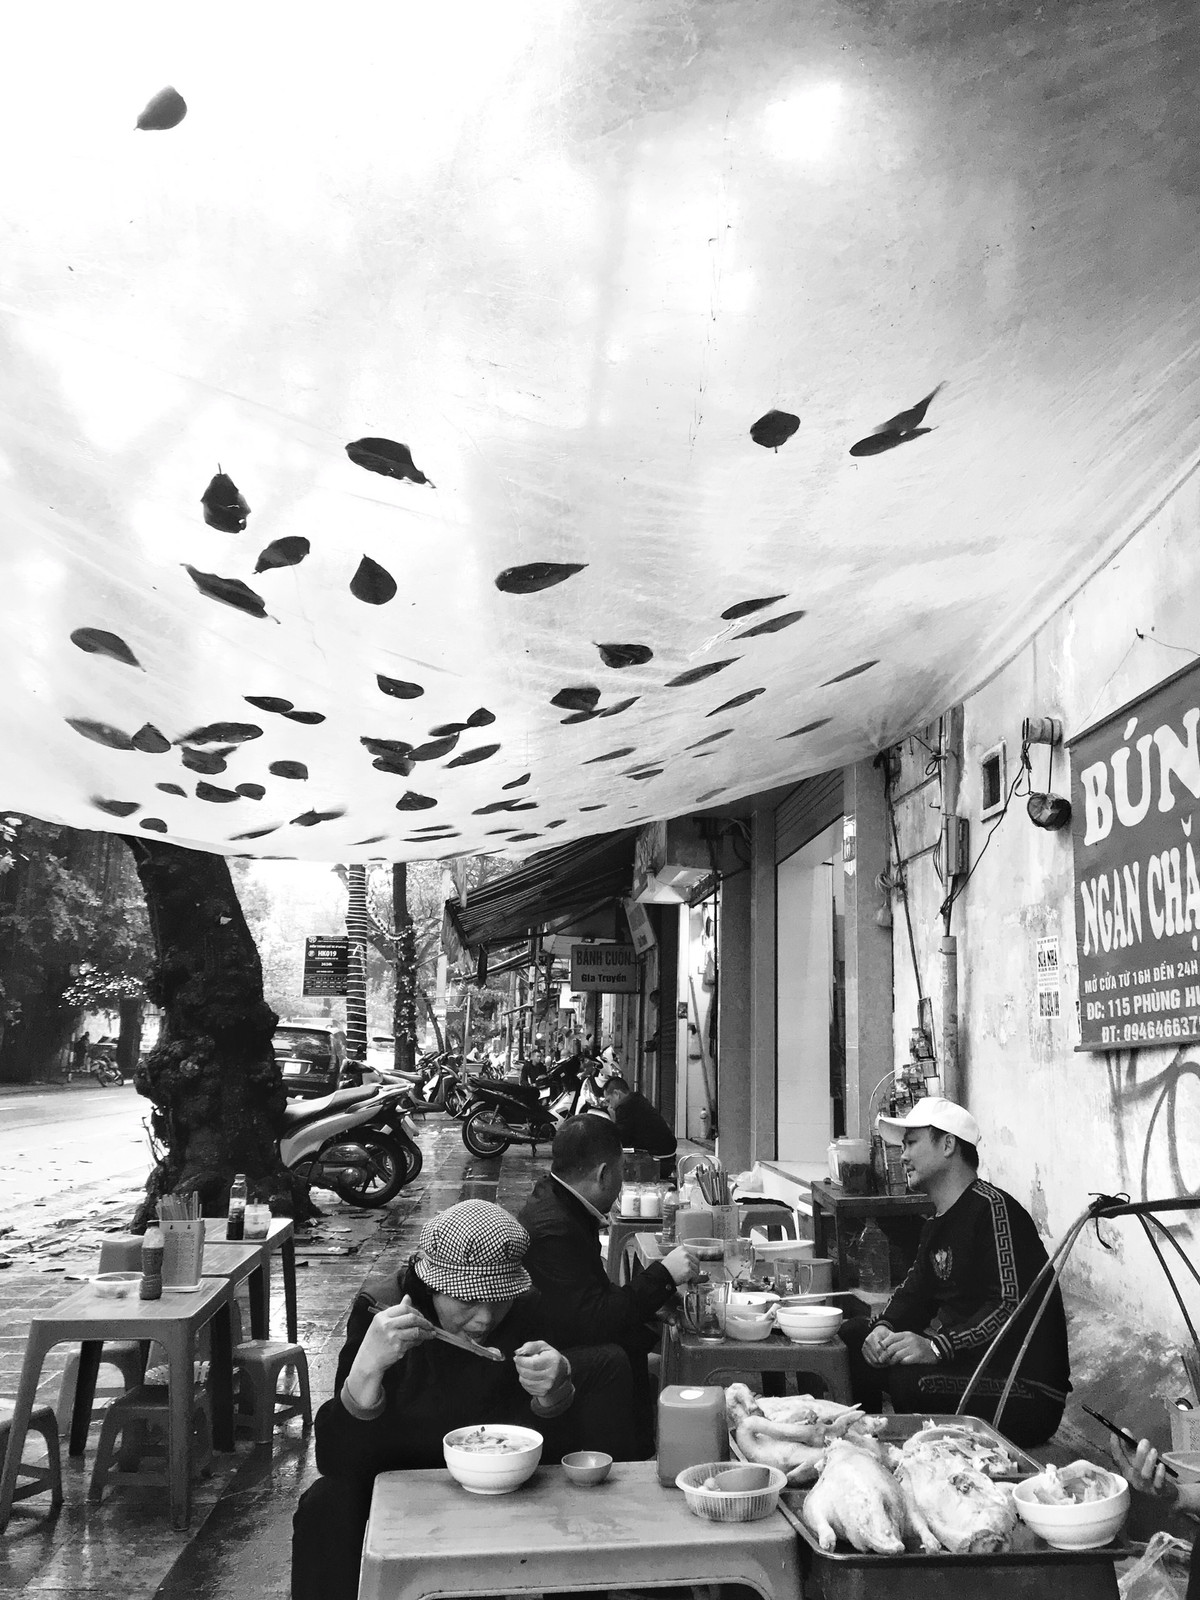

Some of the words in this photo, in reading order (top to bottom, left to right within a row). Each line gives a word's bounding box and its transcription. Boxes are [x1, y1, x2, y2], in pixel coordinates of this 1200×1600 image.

[1081, 708, 1200, 846] BÚN
[1081, 861, 1142, 956] NGAN
[576, 948, 602, 965] BÁNH
[1084, 974, 1098, 994] MỞ
[1099, 972, 1117, 991] CỬA
[1118, 970, 1130, 988] TỪ
[1132, 969, 1151, 985] 16H
[1153, 961, 1175, 981] ĐẾN
[1177, 960, 1198, 978] 24H
[1086, 1001, 1105, 1020] ĐC:
[1107, 997, 1131, 1017] 115
[1133, 988, 1181, 1014] PHÙNG
[1101, 1025, 1120, 1043] ĐT:
[1123, 1016, 1200, 1041] 094646637
